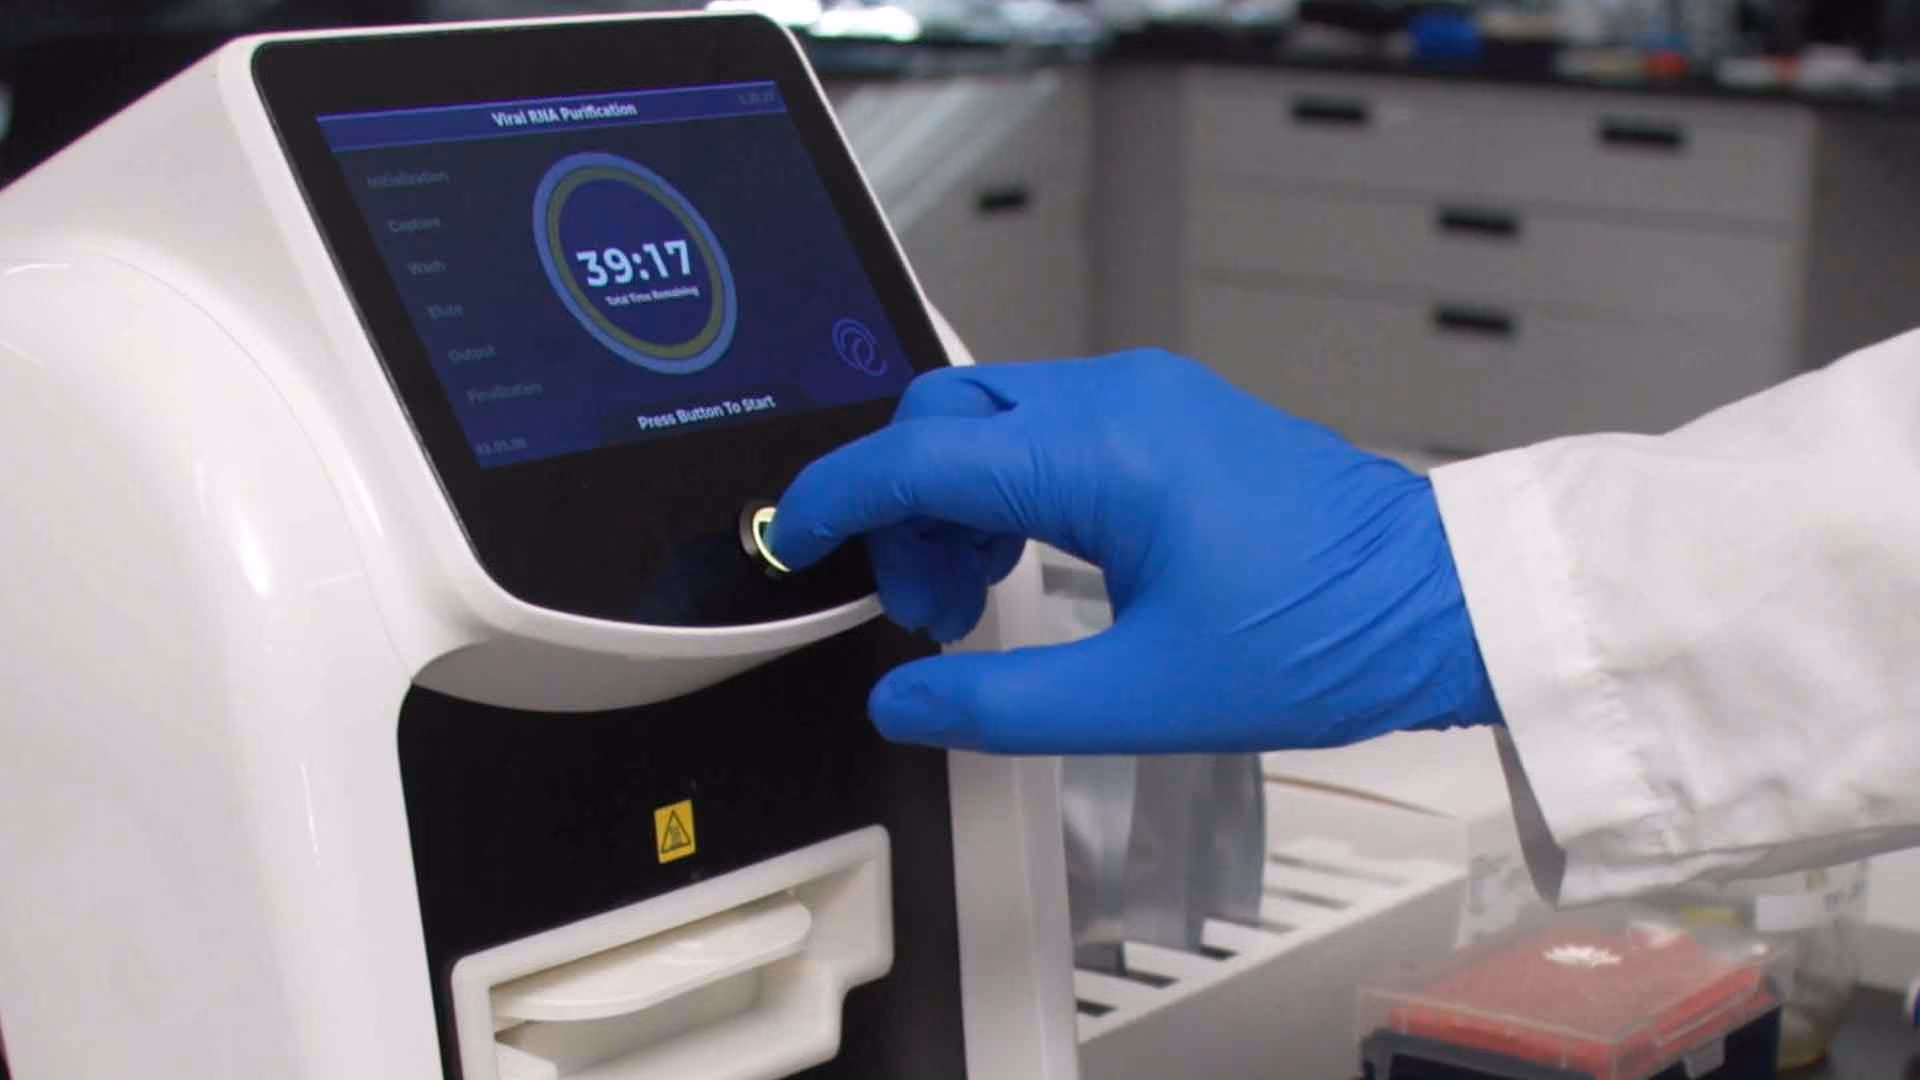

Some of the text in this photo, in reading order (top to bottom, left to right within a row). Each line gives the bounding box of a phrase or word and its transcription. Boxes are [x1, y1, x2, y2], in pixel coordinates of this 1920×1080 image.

[491, 102, 638, 127] Viral RNA Purification
[576, 239, 691, 287] 39:17
[637, 394, 776, 430] Press Button To Start
